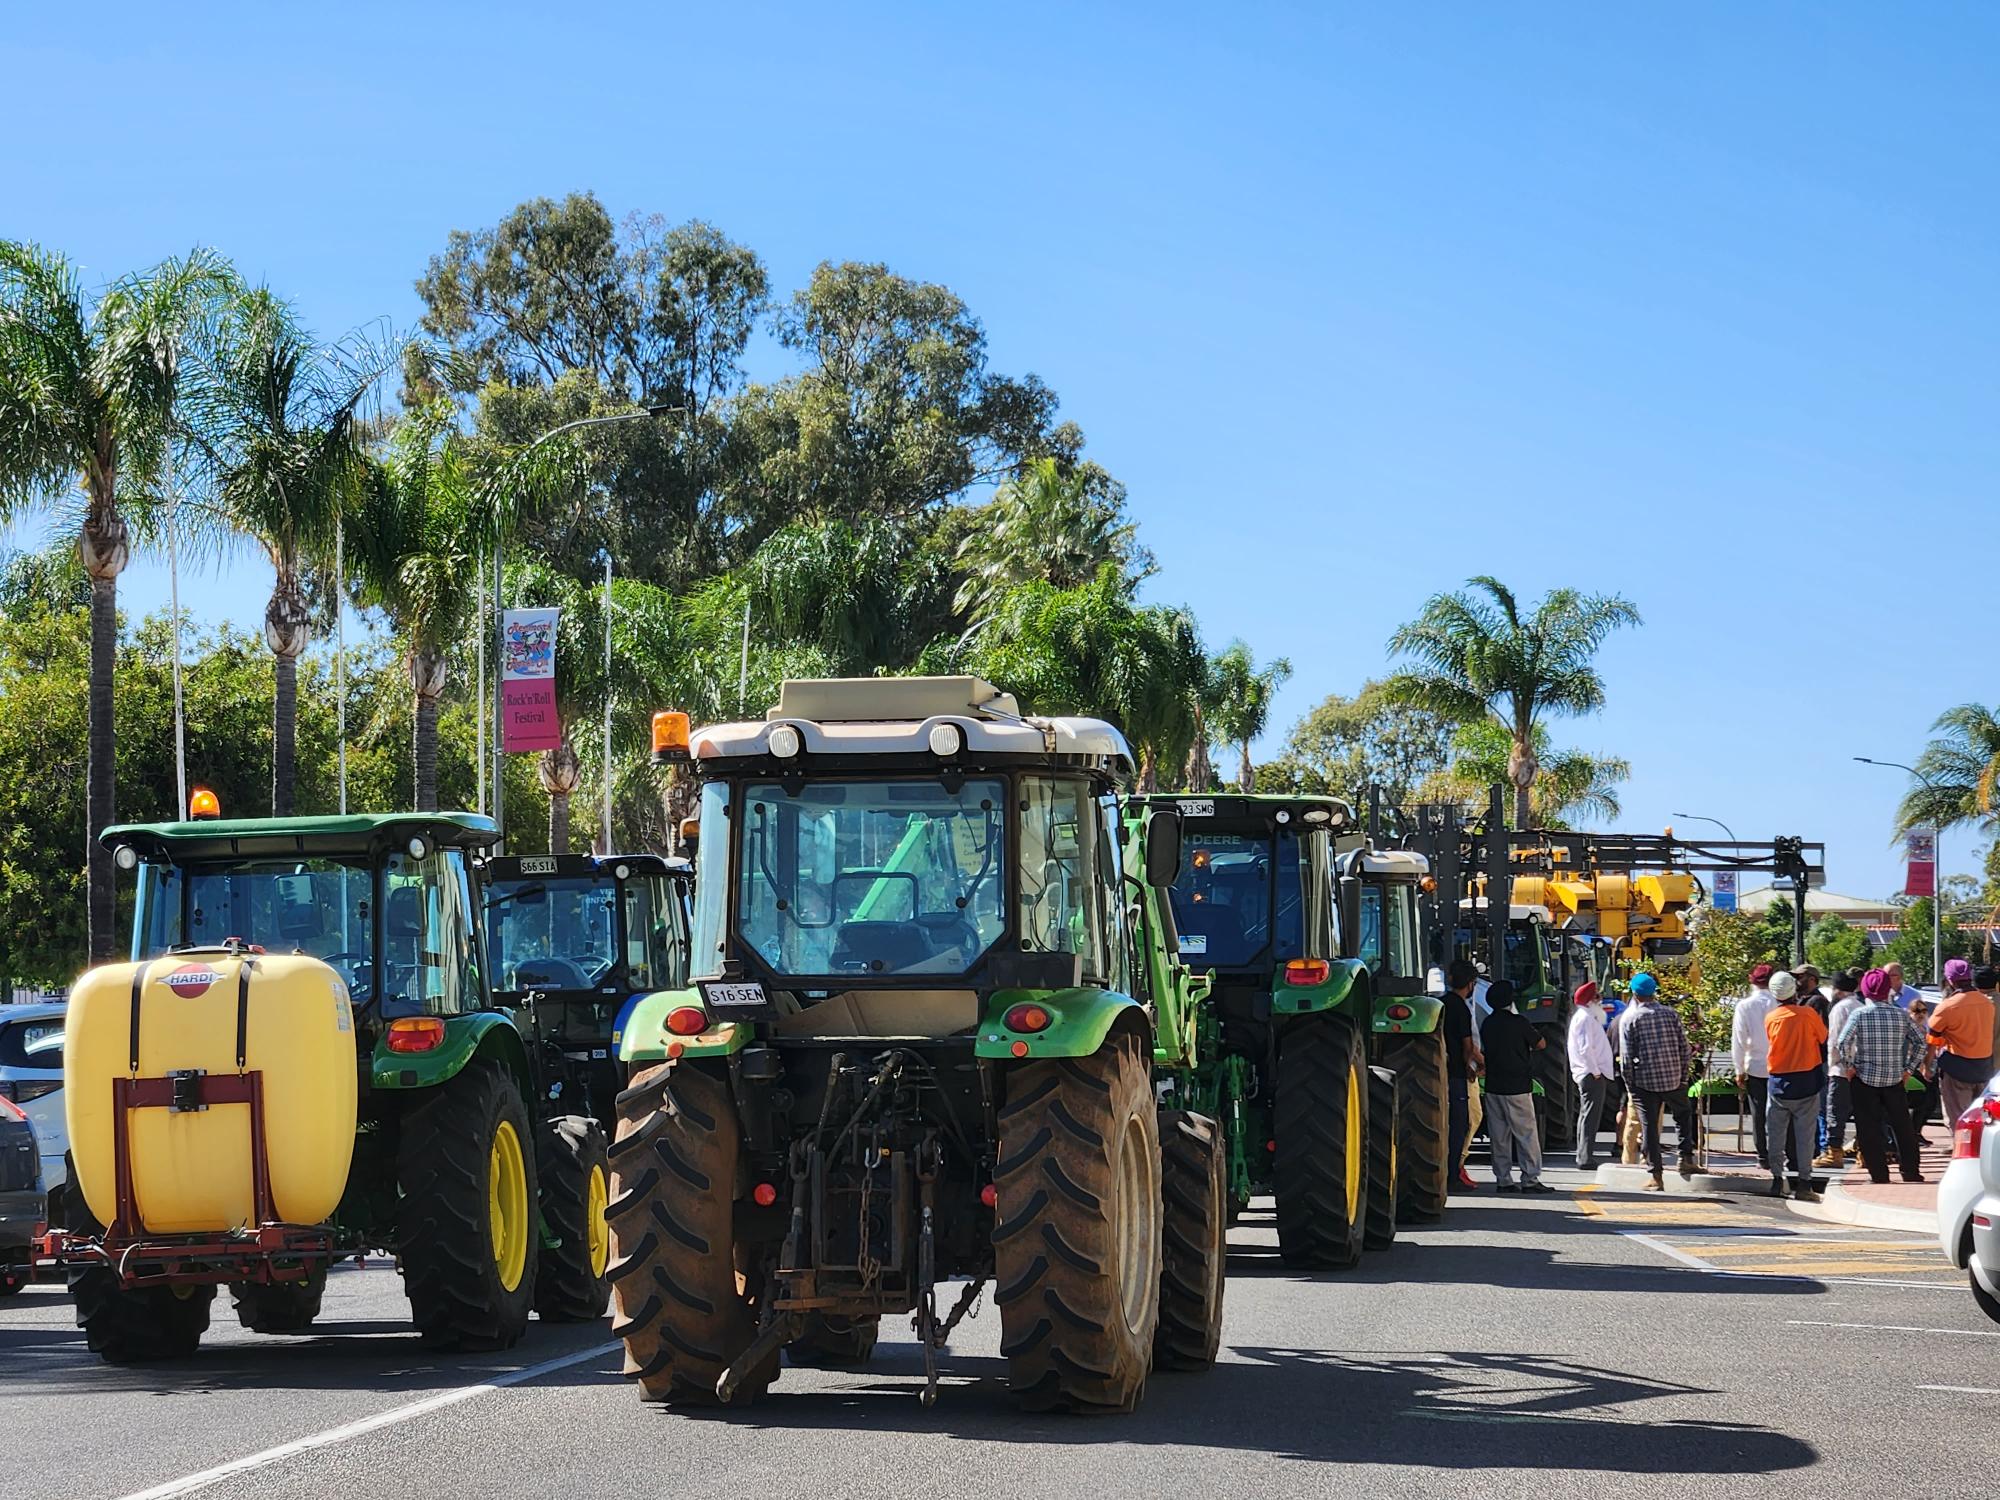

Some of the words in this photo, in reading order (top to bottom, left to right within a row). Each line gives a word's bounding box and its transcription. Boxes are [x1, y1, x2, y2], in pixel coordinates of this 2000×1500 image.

[514, 711, 545, 724] Festival
[1192, 834, 1241, 845] DEERE
[521, 862, 538, 872] S66
[170, 973, 213, 984] HARDI
[711, 990, 736, 1002] S16
[737, 988, 764, 1001] SEN
